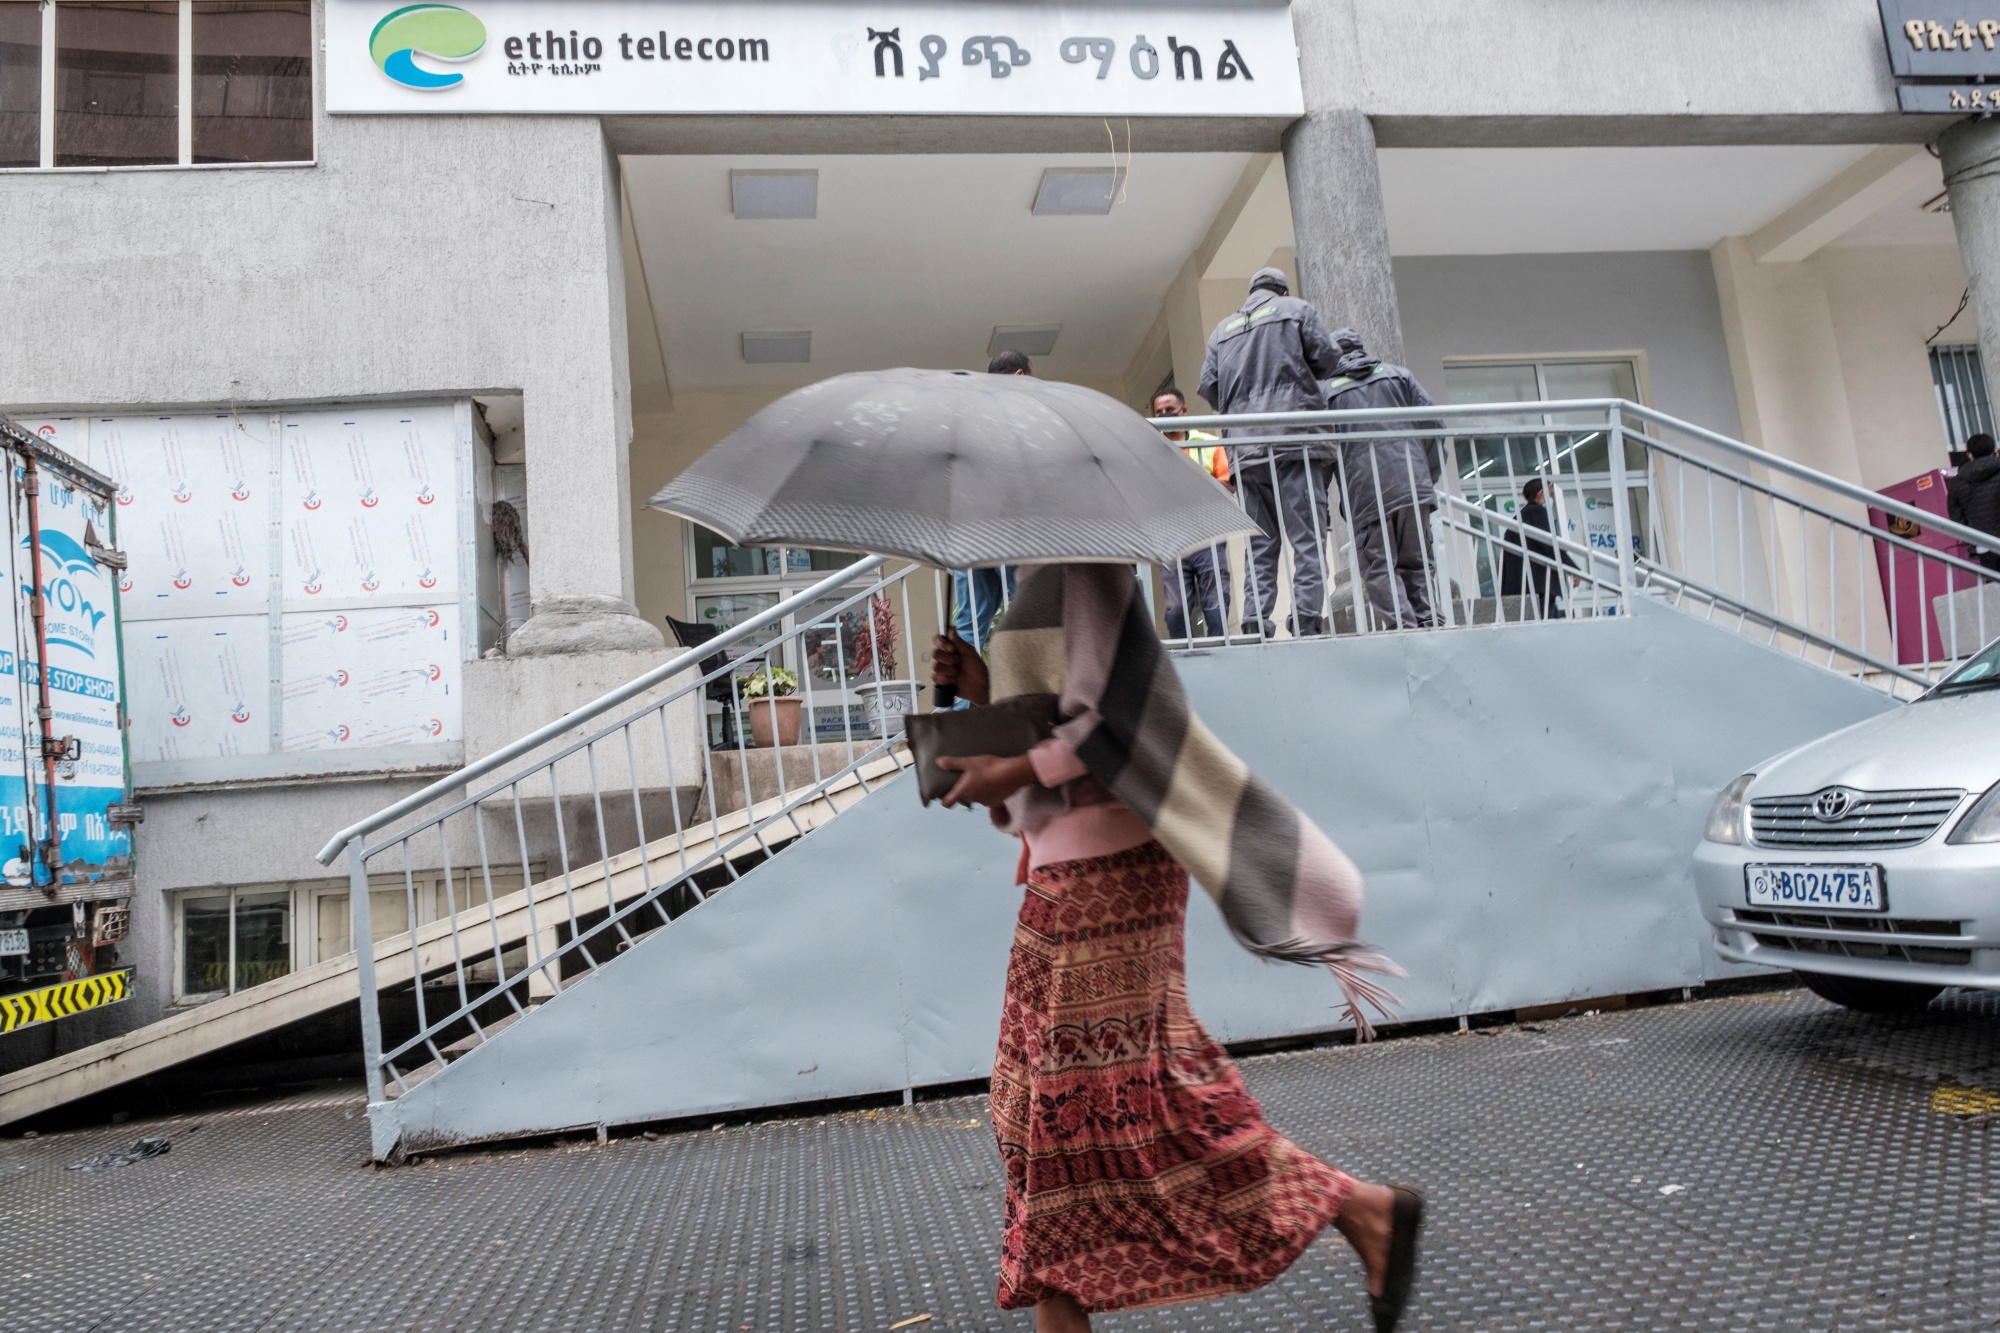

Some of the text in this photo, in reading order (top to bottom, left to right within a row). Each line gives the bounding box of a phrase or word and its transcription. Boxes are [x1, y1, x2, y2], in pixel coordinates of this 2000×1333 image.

[504, 30, 770, 62] ethio telecom
[1589, 533, 1642, 550] FASR
[69, 625, 96, 650] STORE
[54, 670, 83, 693] STOP
[85, 677, 114, 700] SHOP
[813, 704, 865, 715] OBILE DAT
[821, 715, 861, 724] PACKGE
[1781, 871, 1861, 903] B02475
